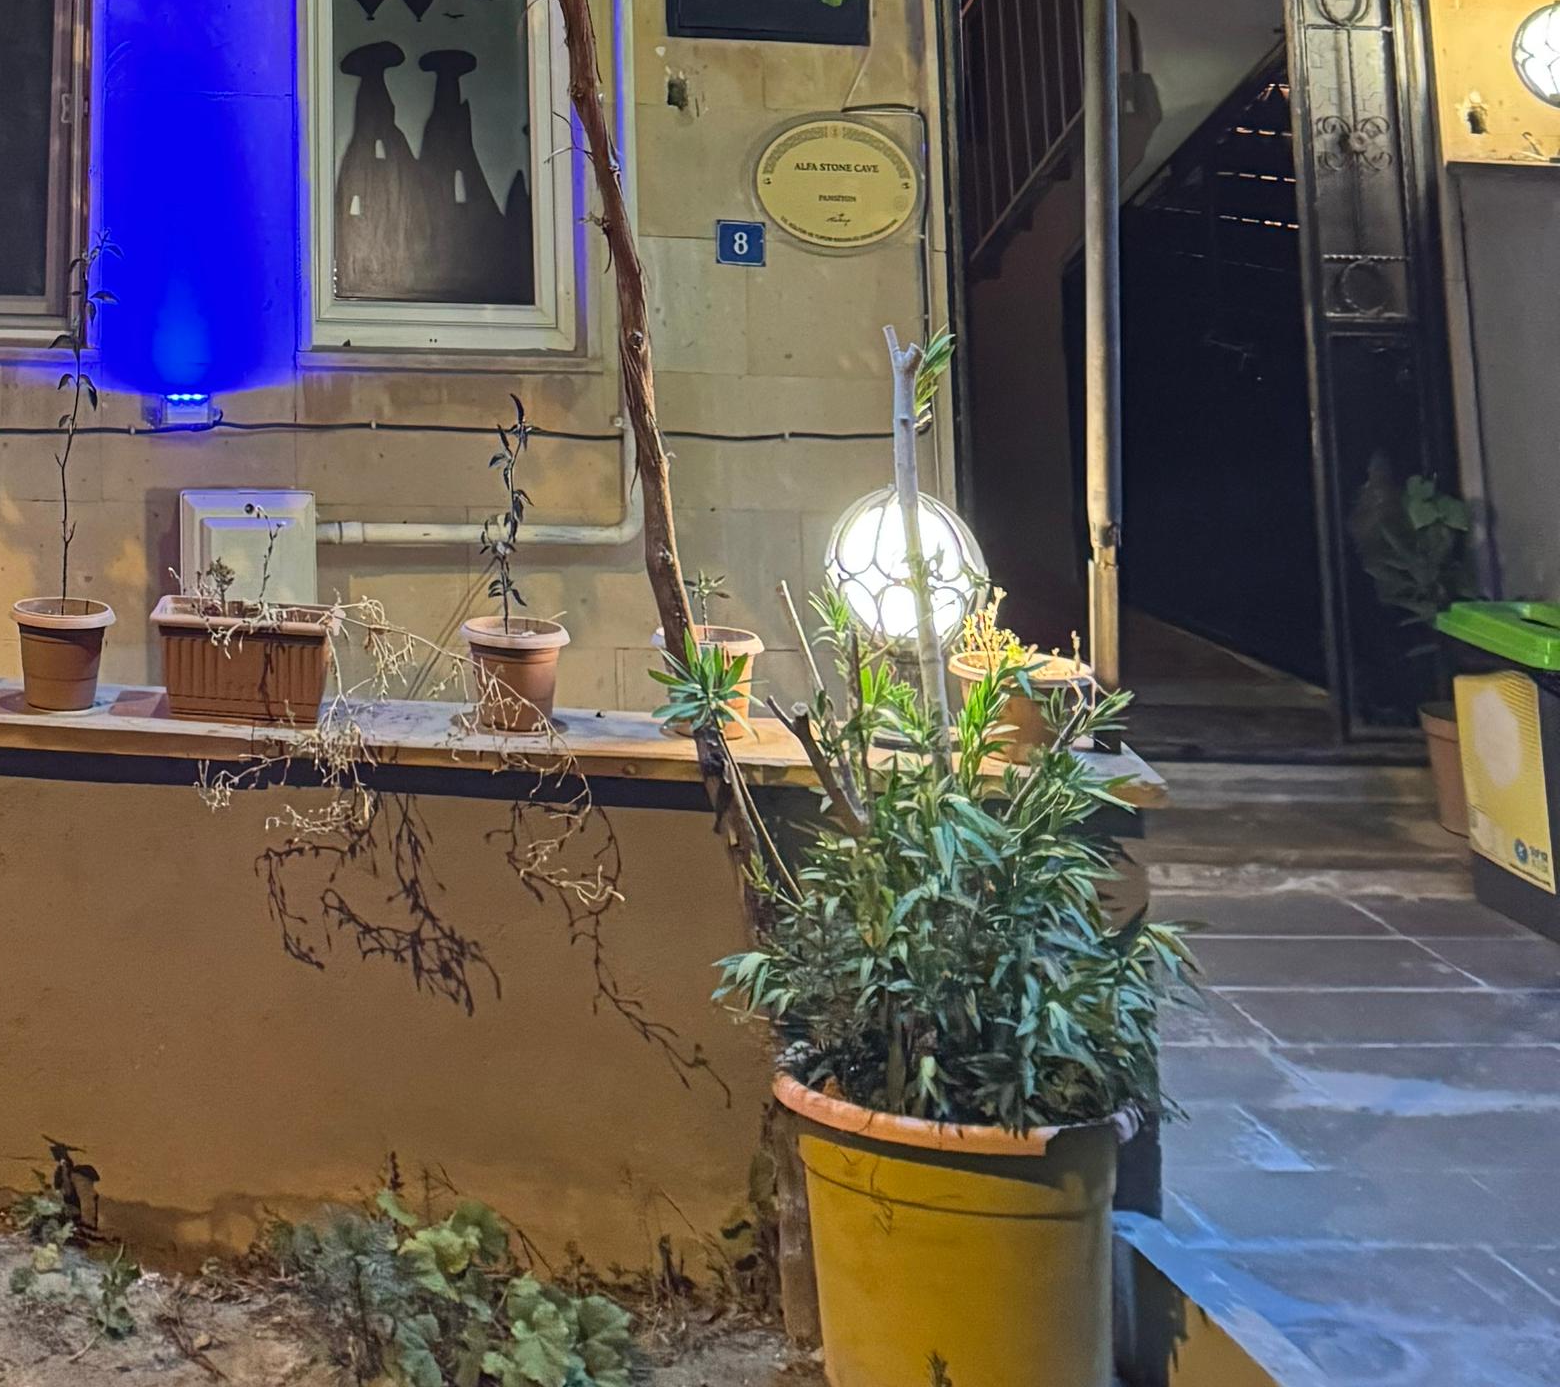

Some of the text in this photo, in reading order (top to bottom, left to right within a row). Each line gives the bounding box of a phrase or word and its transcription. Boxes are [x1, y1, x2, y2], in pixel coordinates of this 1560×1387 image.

[794, 162, 880, 174] ALFA STONE CAVE
[733, 231, 749, 255] 8
